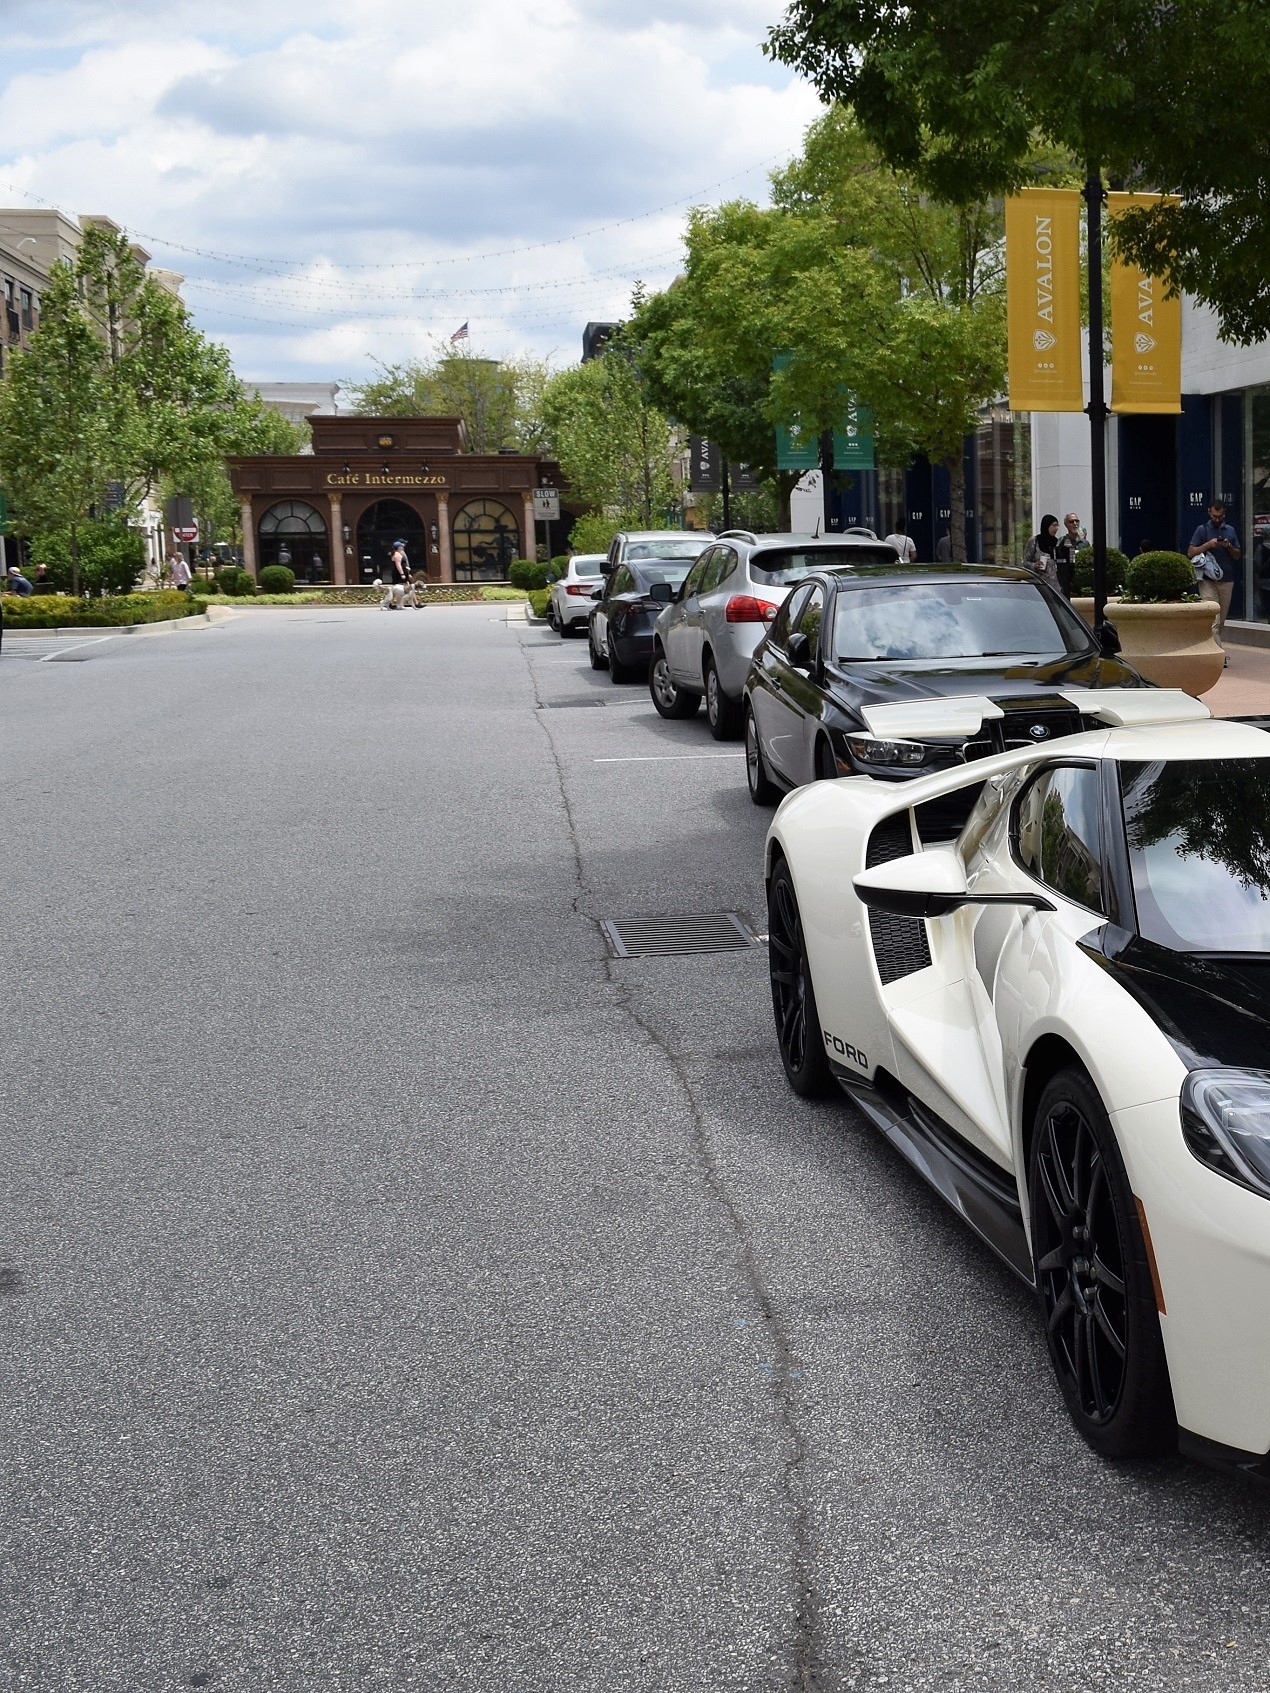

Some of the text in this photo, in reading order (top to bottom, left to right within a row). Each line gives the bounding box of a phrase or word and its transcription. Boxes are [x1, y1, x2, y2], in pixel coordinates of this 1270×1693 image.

[1036, 215, 1053, 324] AVALON
[327, 473, 446, 485] Café Intermezzo
[536, 490, 556, 498] SLOW
[1189, 492, 1203, 503] GAP
[1129, 496, 1142, 506] GAP
[823, 1029, 869, 1070] FORD
